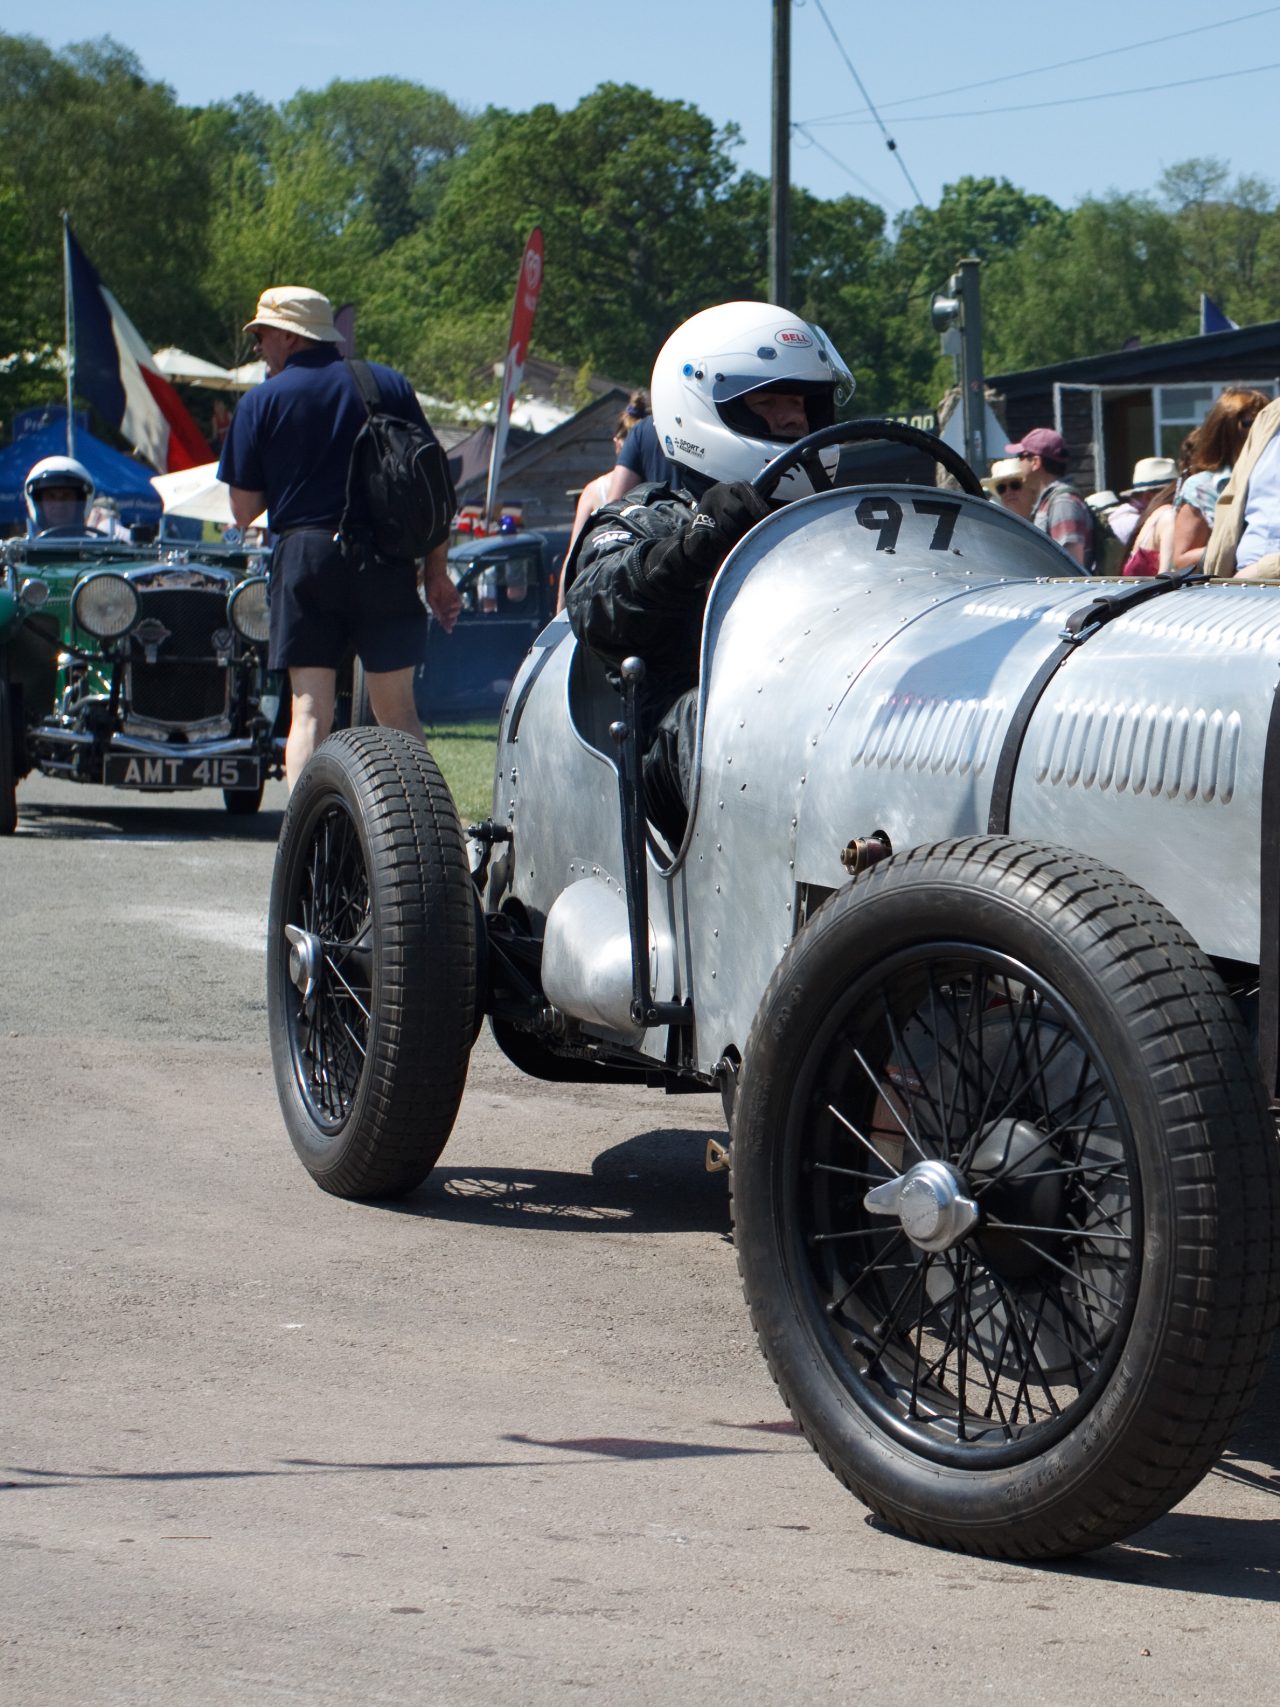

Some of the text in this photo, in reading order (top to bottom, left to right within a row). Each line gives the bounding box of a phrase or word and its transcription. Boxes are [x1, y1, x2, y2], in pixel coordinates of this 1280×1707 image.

[781, 333, 808, 343] BELL
[680, 438, 699, 452] SPORT
[855, 496, 962, 551] 97
[124, 758, 240, 785] AMT 415
